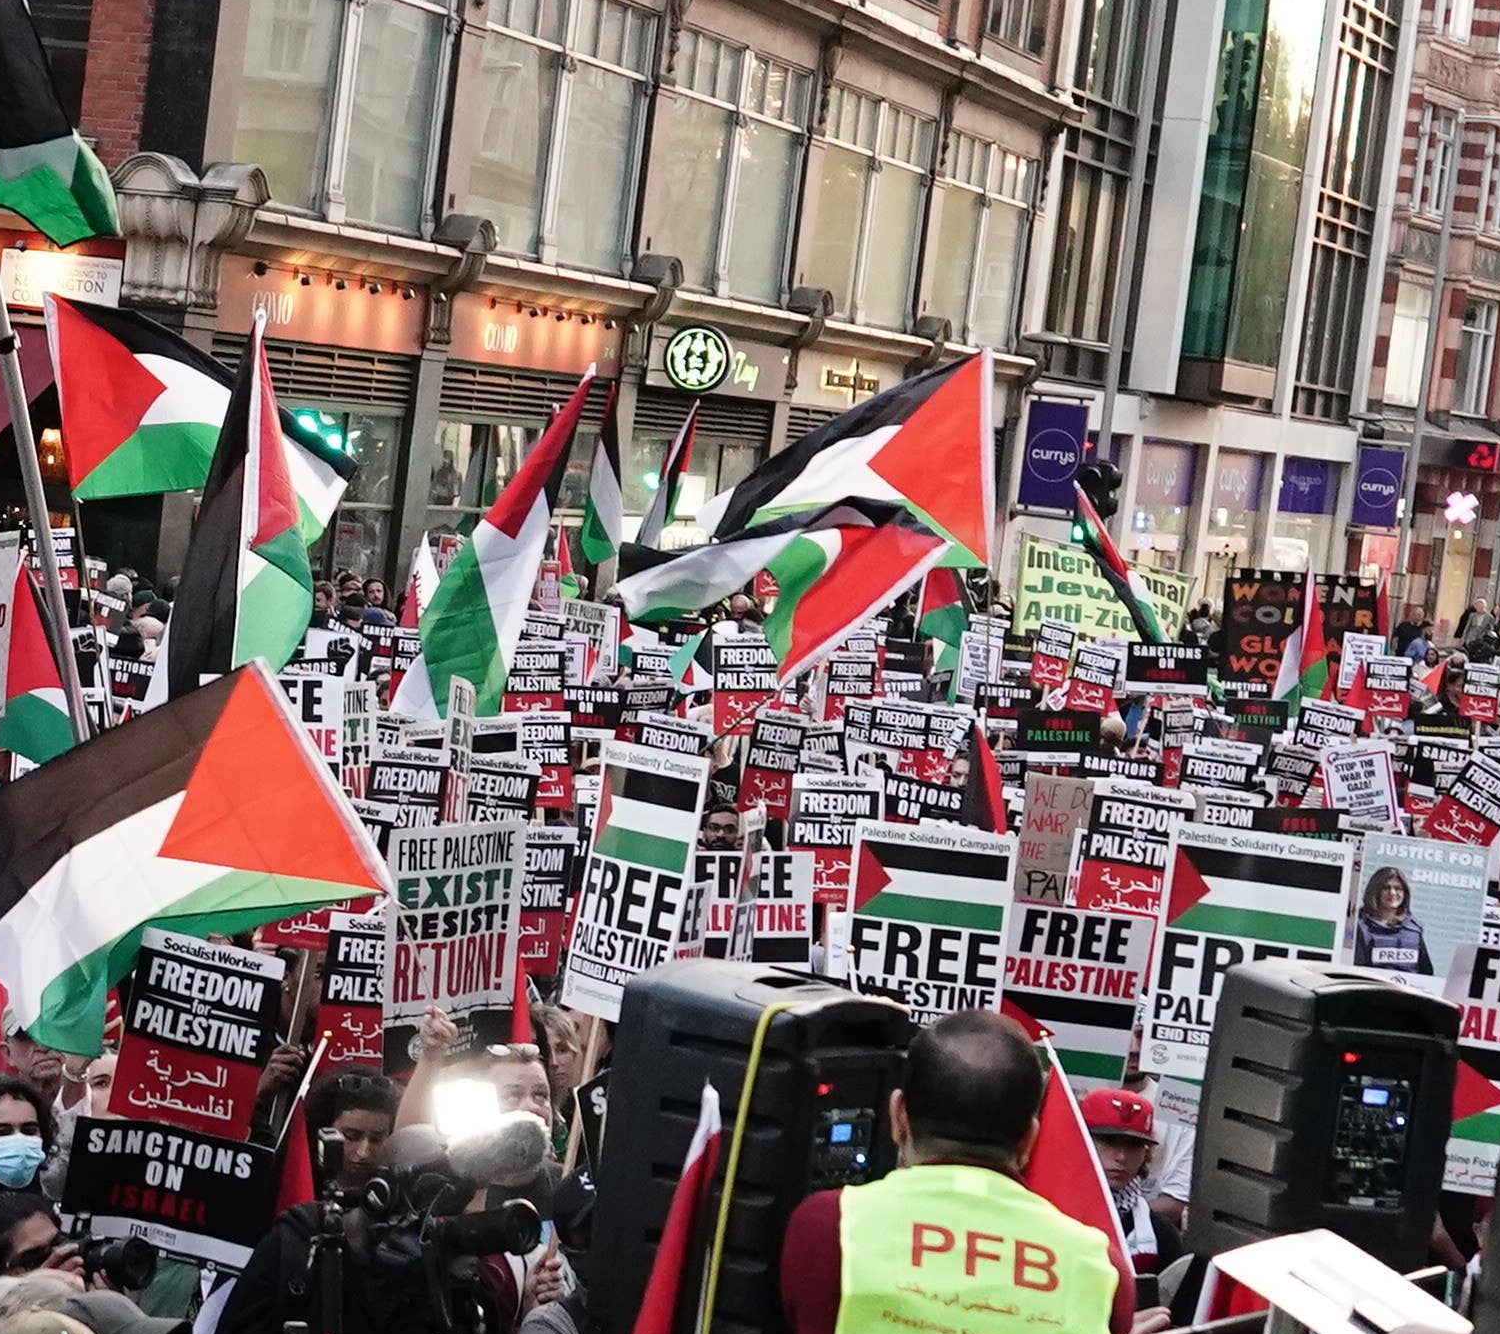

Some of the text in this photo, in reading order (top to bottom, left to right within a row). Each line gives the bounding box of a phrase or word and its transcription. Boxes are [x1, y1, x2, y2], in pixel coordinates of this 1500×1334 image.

[1031, 446, 1076, 467] currys
[512, 653, 560, 670] FREEDOM
[1078, 652, 1116, 670] FREEDOM
[1133, 645, 1202, 660] SANCTIONS
[1159, 658, 1175, 669] ON
[508, 673, 561, 692] PALESTINE
[1074, 668, 1115, 687] PALESTINE
[1370, 664, 1408, 678] FREEDOM
[978, 685, 1032, 701] SANCTIONS
[1367, 677, 1408, 691] PALESTINE
[876, 710, 926, 731] FREEDOM
[758, 724, 801, 747] FREEDOM
[871, 730, 926, 750] PALESTINE
[1027, 730, 1091, 743] PALESTINE
[750, 750, 798, 772] PALESTINE
[1084, 756, 1157, 778] SANCTIONS
[372, 768, 441, 796] FREEDOM
[1187, 763, 1247, 785] FREEDOM
[800, 793, 880, 816] FREEDOM
[1099, 802, 1185, 836] FREEDOM
[398, 830, 515, 873] FREE PALESTINE
[861, 825, 1012, 854] Palestine Solidarity Campaign
[1177, 829, 1346, 862] Palestine Solidarity Campaign
[1375, 842, 1486, 867] JUSTICE FOR
[400, 871, 512, 910] EXIST!
[1100, 871, 1163, 895] الحرية
[1411, 867, 1484, 891] SHIREEN
[586, 857, 678, 943] FREE
[396, 906, 509, 941] RESIST!
[1019, 908, 1134, 964] FREE
[164, 937, 263, 972] Socialist Worker
[574, 921, 668, 966] PALESTINE
[852, 919, 1000, 988] FREE
[1379, 948, 1416, 962] PRESS
[393, 933, 504, 1004] RETURN!
[1003, 957, 1139, 999] PALESTINE
[148, 957, 264, 1012] FREEDOM
[133, 1000, 261, 1059] PALESTINE
[145, 1049, 227, 1088] الحرية
[128, 1085, 234, 1120] لفلسطين
[88, 1127, 253, 1179] SANCTIONS
[145, 1160, 184, 1191] ON
[911, 1222, 1060, 1294] PFB
